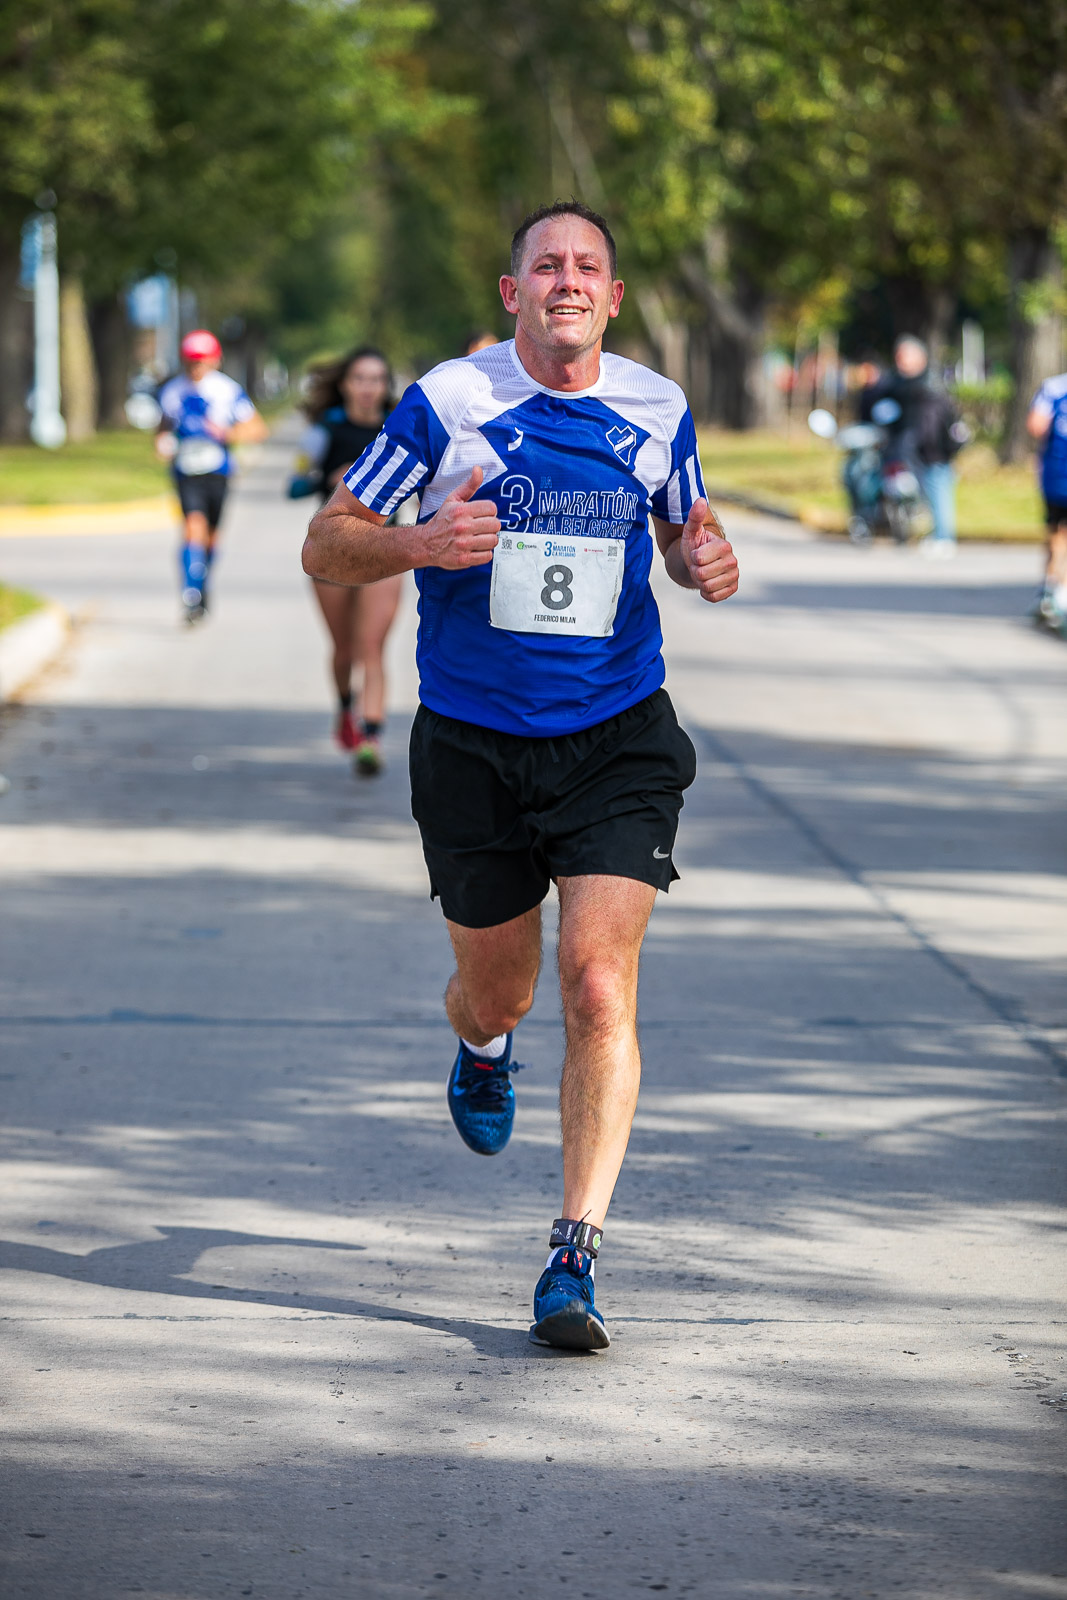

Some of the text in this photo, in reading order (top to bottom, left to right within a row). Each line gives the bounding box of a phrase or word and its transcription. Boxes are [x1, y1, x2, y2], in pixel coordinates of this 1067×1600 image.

[500, 474, 534, 533] 3
[538, 486, 639, 520] MARATÓN
[544, 541, 553, 557] 3
[540, 564, 574, 611] 8
[534, 614, 576, 624] FEDERICO MILAN
